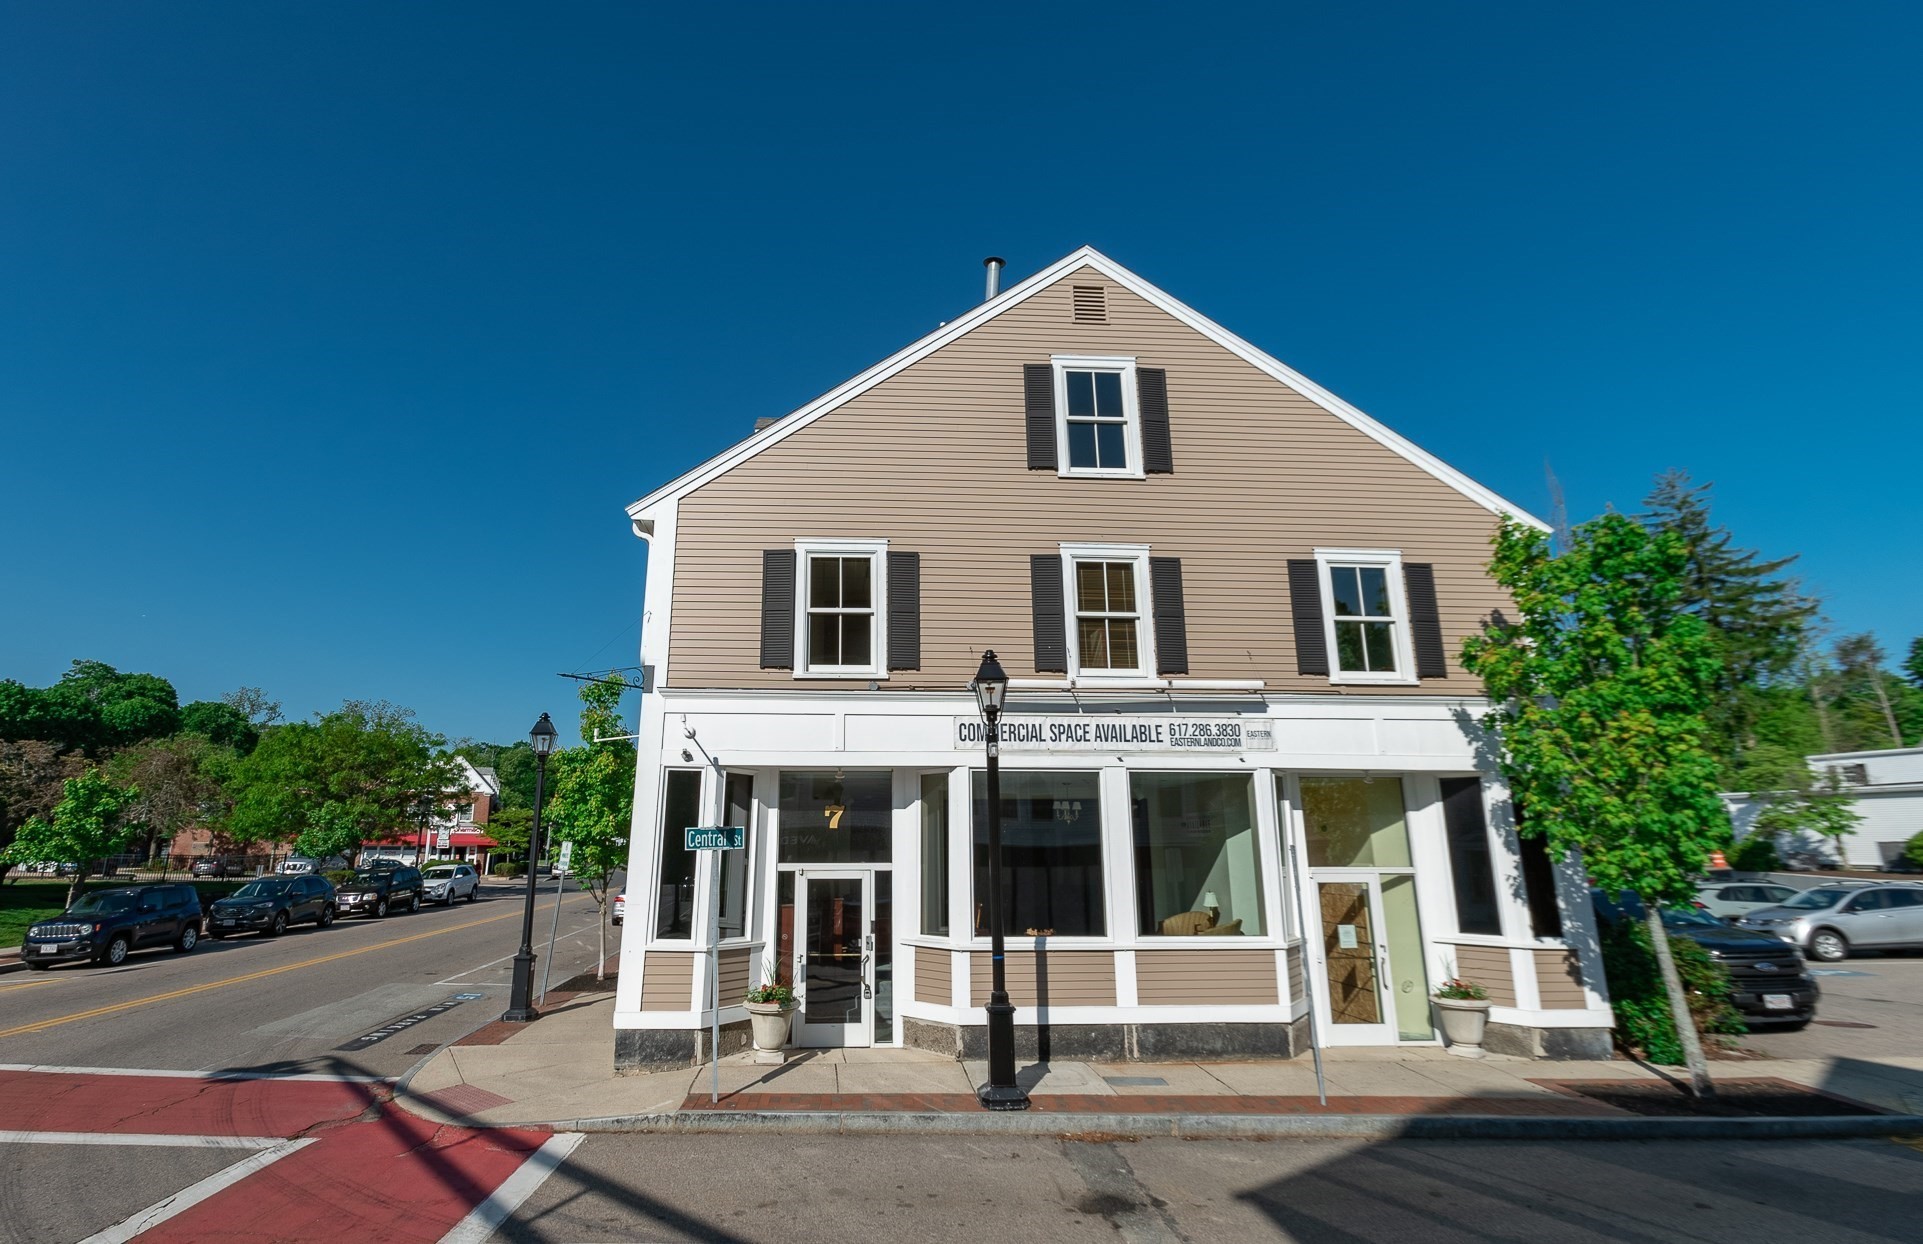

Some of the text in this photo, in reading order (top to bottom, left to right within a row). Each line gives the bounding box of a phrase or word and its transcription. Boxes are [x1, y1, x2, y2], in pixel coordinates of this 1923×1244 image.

[958, 722, 1164, 743] COMERCIAL SPACE AVAILABLE
[1169, 723, 1241, 738] 617.286.3830
[1246, 730, 1272, 738] EASTERN
[1170, 737, 1241, 747] EASTERNLANDCO.COM
[824, 804, 846, 829] 7
[688, 830, 742, 847] Central St
[361, 1014, 427, 1041] PARKING
